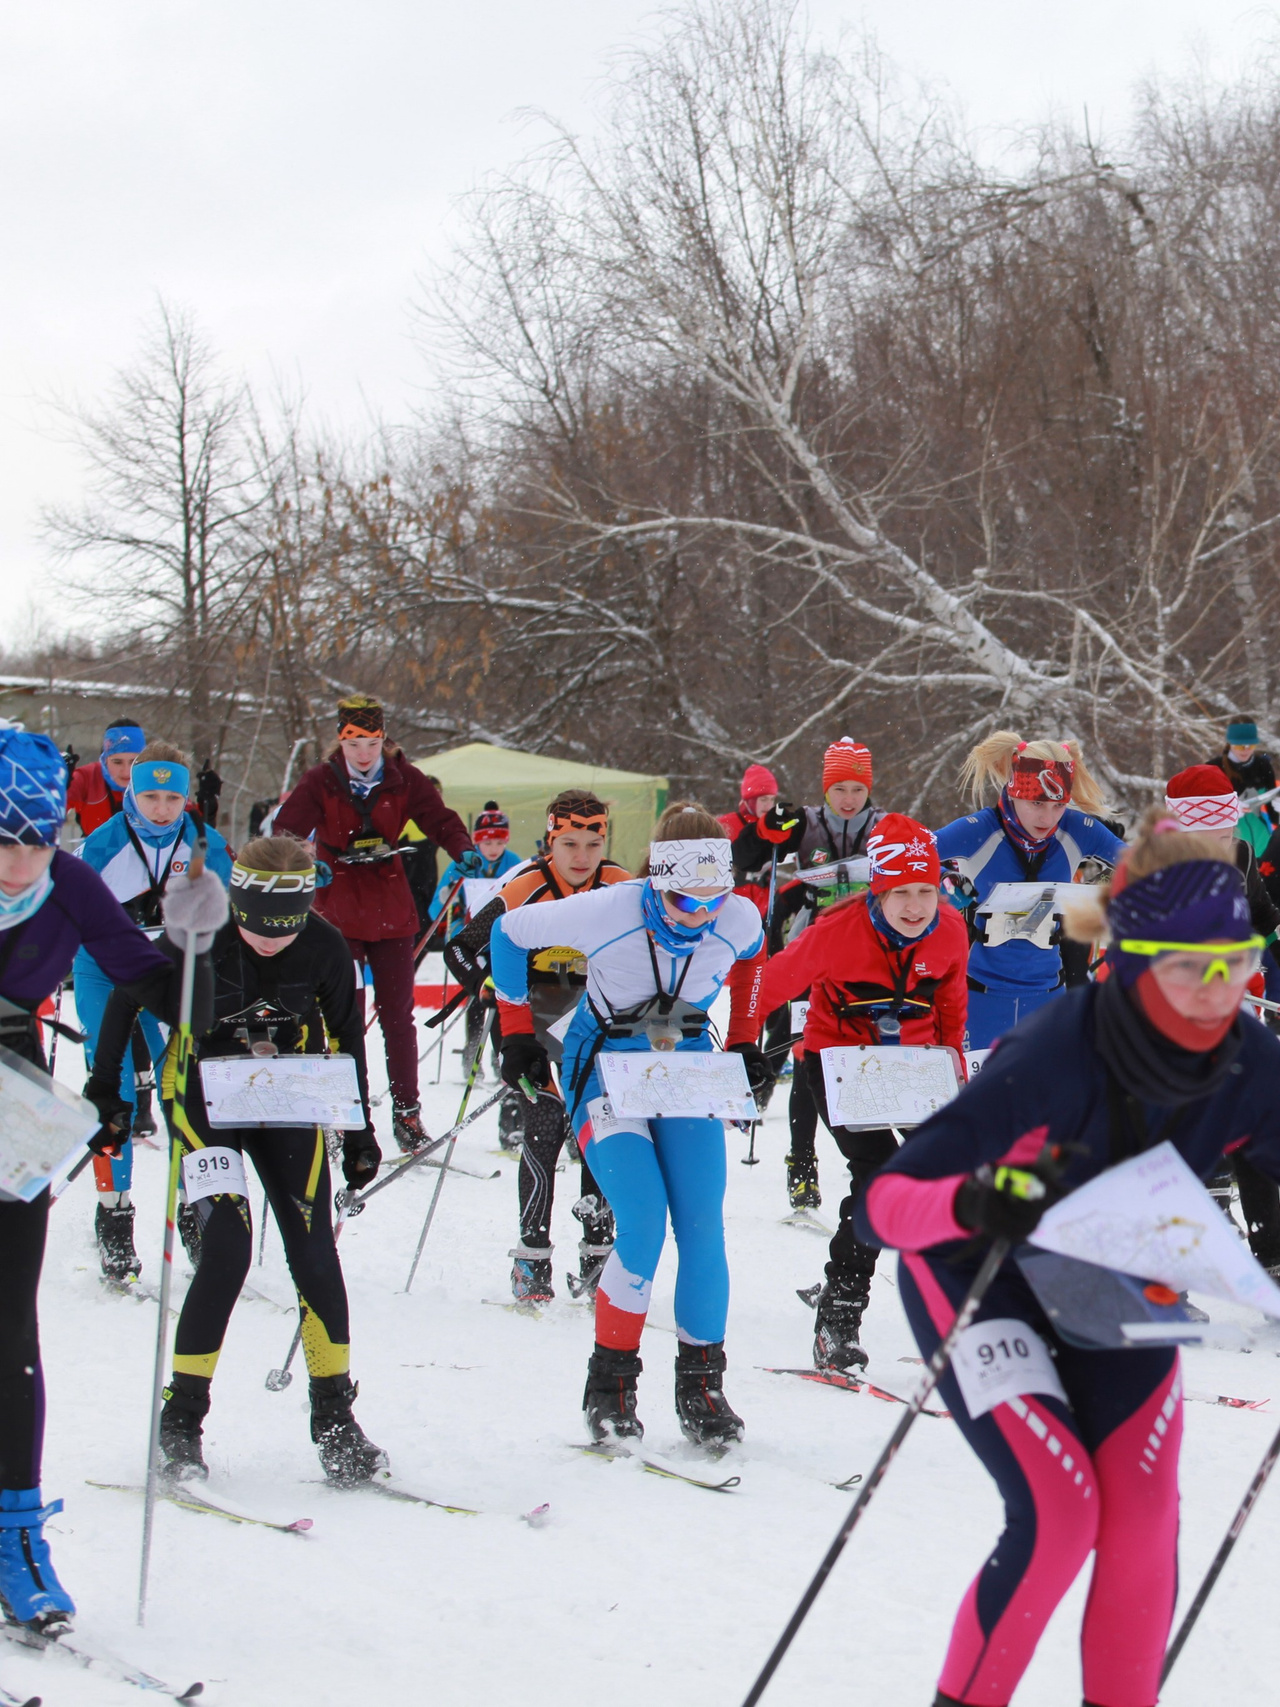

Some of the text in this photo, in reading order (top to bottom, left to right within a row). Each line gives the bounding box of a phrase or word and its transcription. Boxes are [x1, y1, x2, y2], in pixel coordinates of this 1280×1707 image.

[907, 861, 928, 873] R
[747, 966, 763, 1018] NORDSKI
[198, 1156, 230, 1173] 919
[832, 1299, 862, 1307] SPINE
[977, 1337, 1030, 1365] 910
